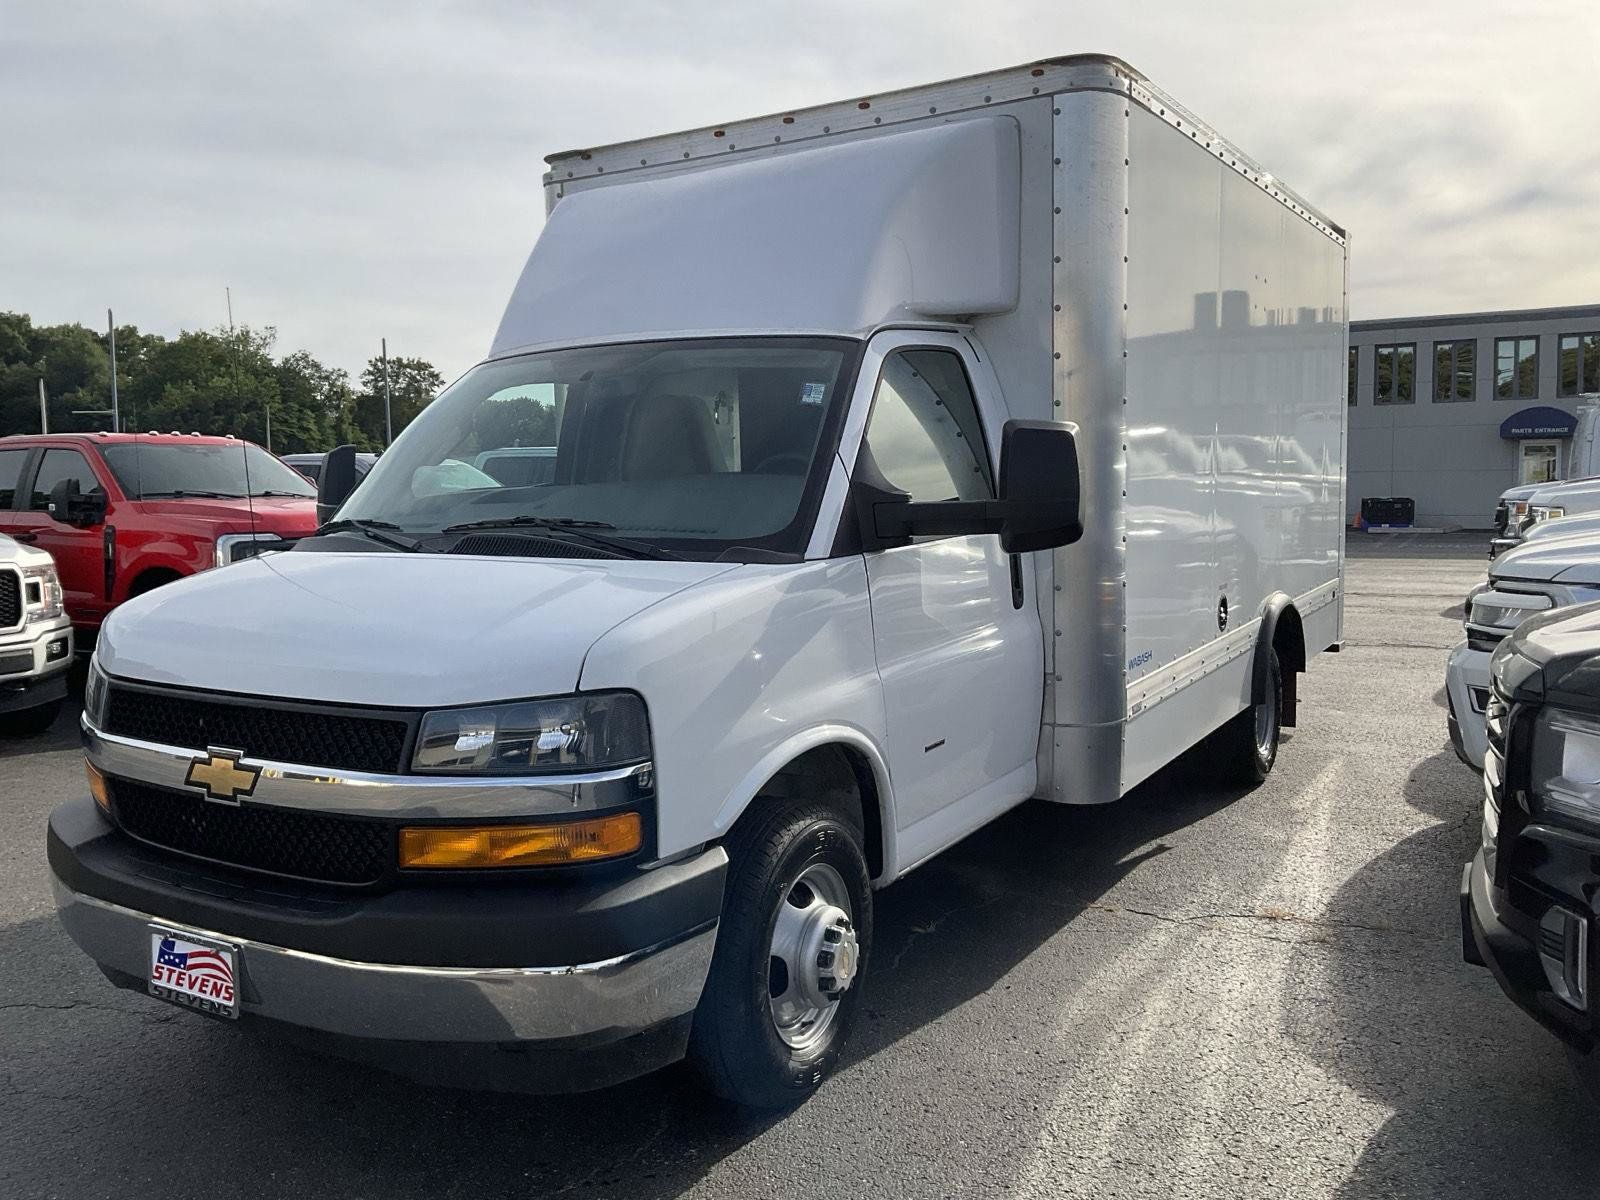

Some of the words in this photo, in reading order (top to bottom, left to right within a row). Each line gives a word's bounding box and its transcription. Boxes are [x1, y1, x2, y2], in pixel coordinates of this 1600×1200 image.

[1534, 426, 1569, 434] ENTRANCE
[1128, 649, 1153, 671] WABASH
[152, 964, 234, 1002] STEVENS
[153, 985, 234, 1017] STEVENS
